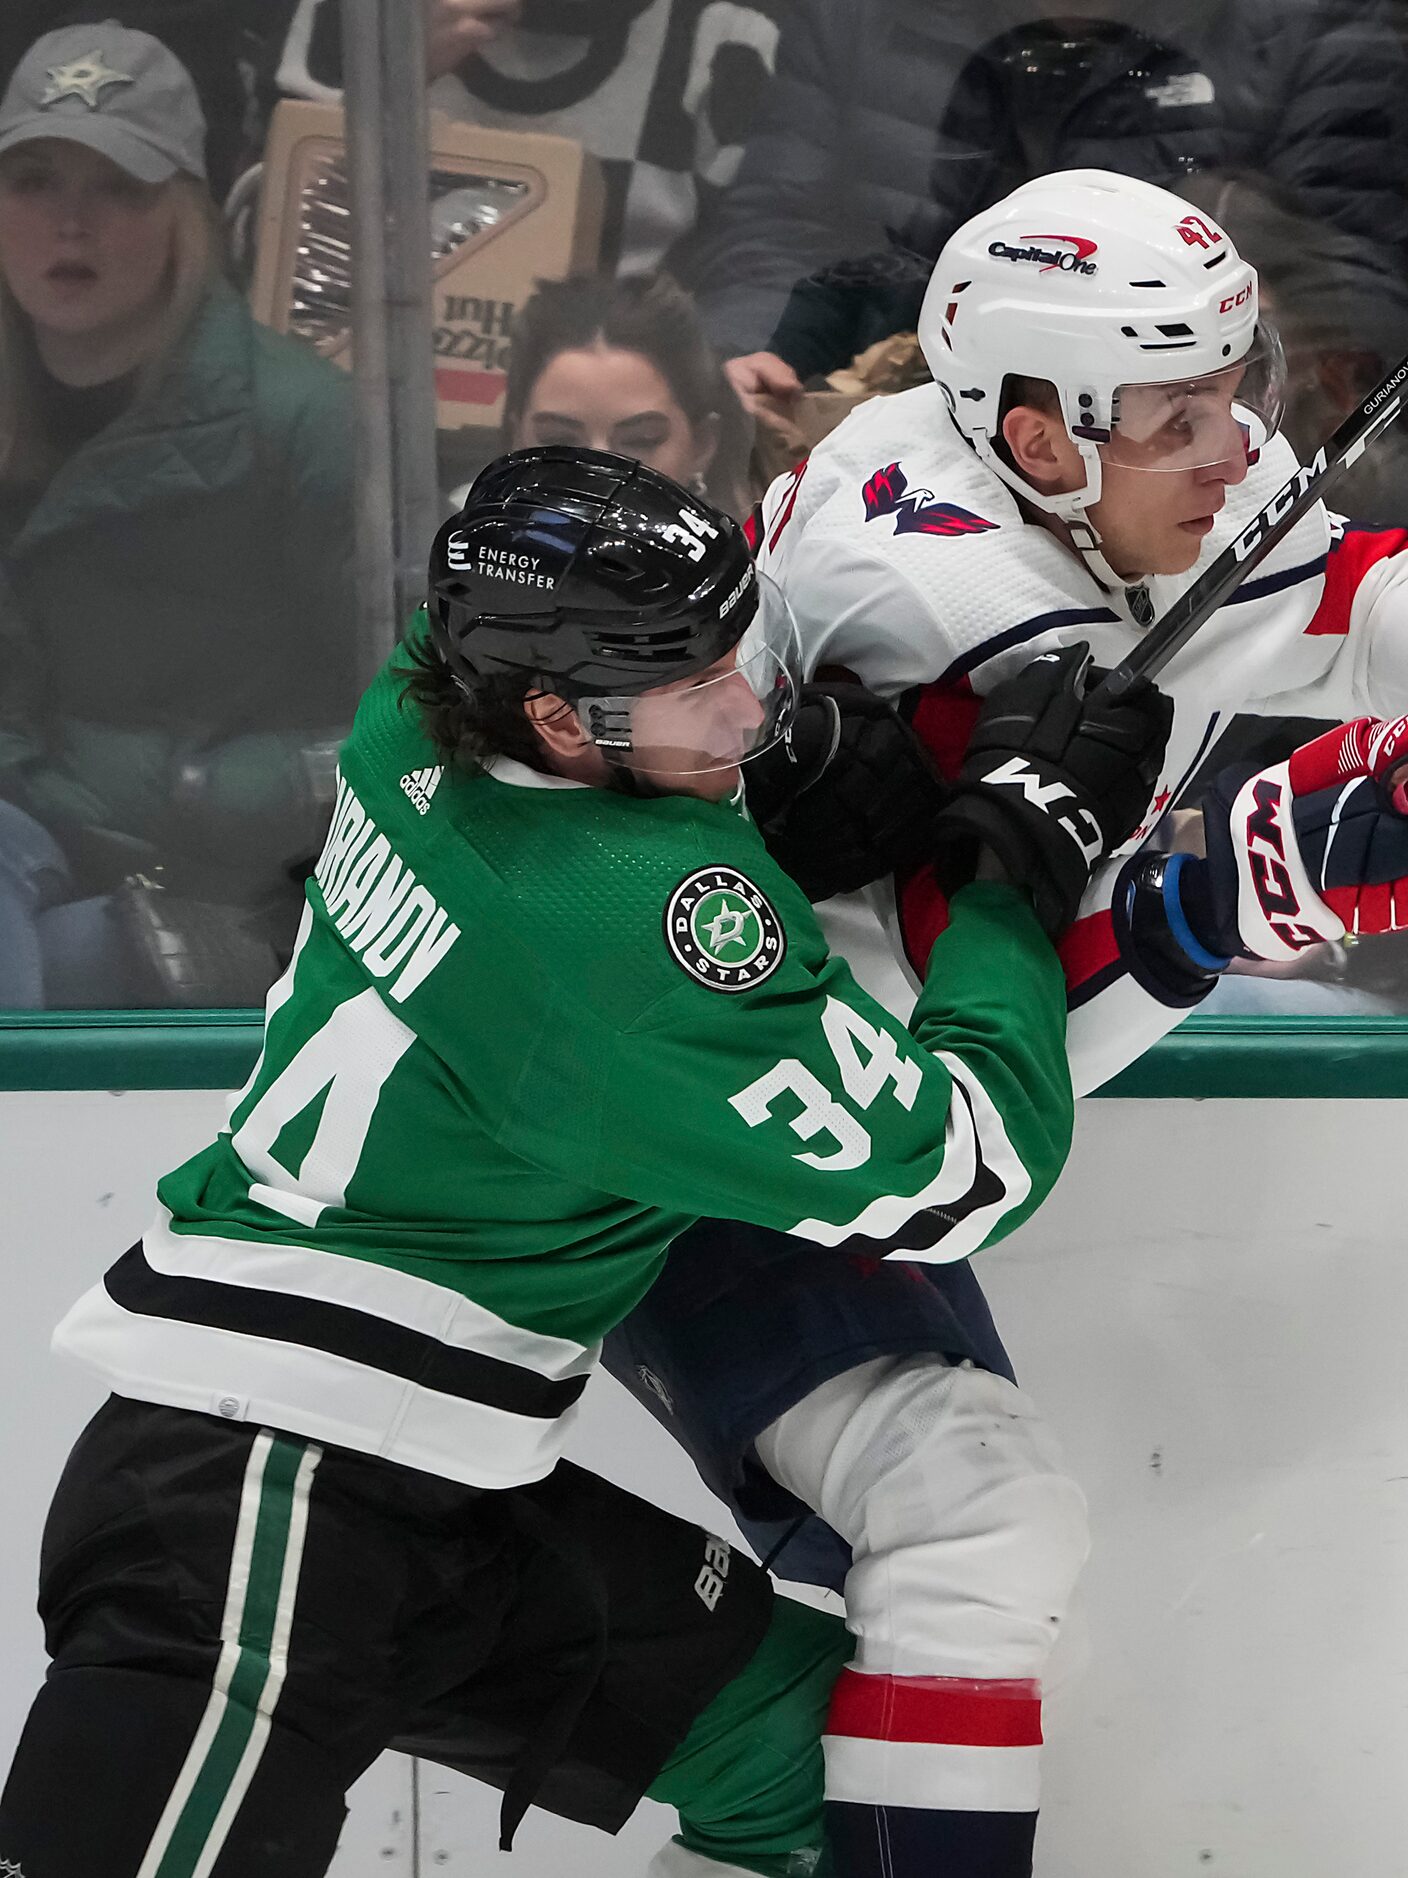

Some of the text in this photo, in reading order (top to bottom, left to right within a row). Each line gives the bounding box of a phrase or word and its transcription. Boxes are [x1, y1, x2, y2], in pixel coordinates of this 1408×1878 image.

[1175, 215, 1223, 250] 42
[1230, 445, 1328, 562] CCM
[478, 546, 540, 570] ENERGY
[662, 508, 719, 562] 34
[477, 561, 555, 590] TRANSFER
[399, 774, 431, 816] adidas
[1246, 778, 1328, 952] CCM
[675, 874, 763, 935] DALLAS
[694, 935, 778, 982] STARS
[726, 993, 924, 1172] 34
